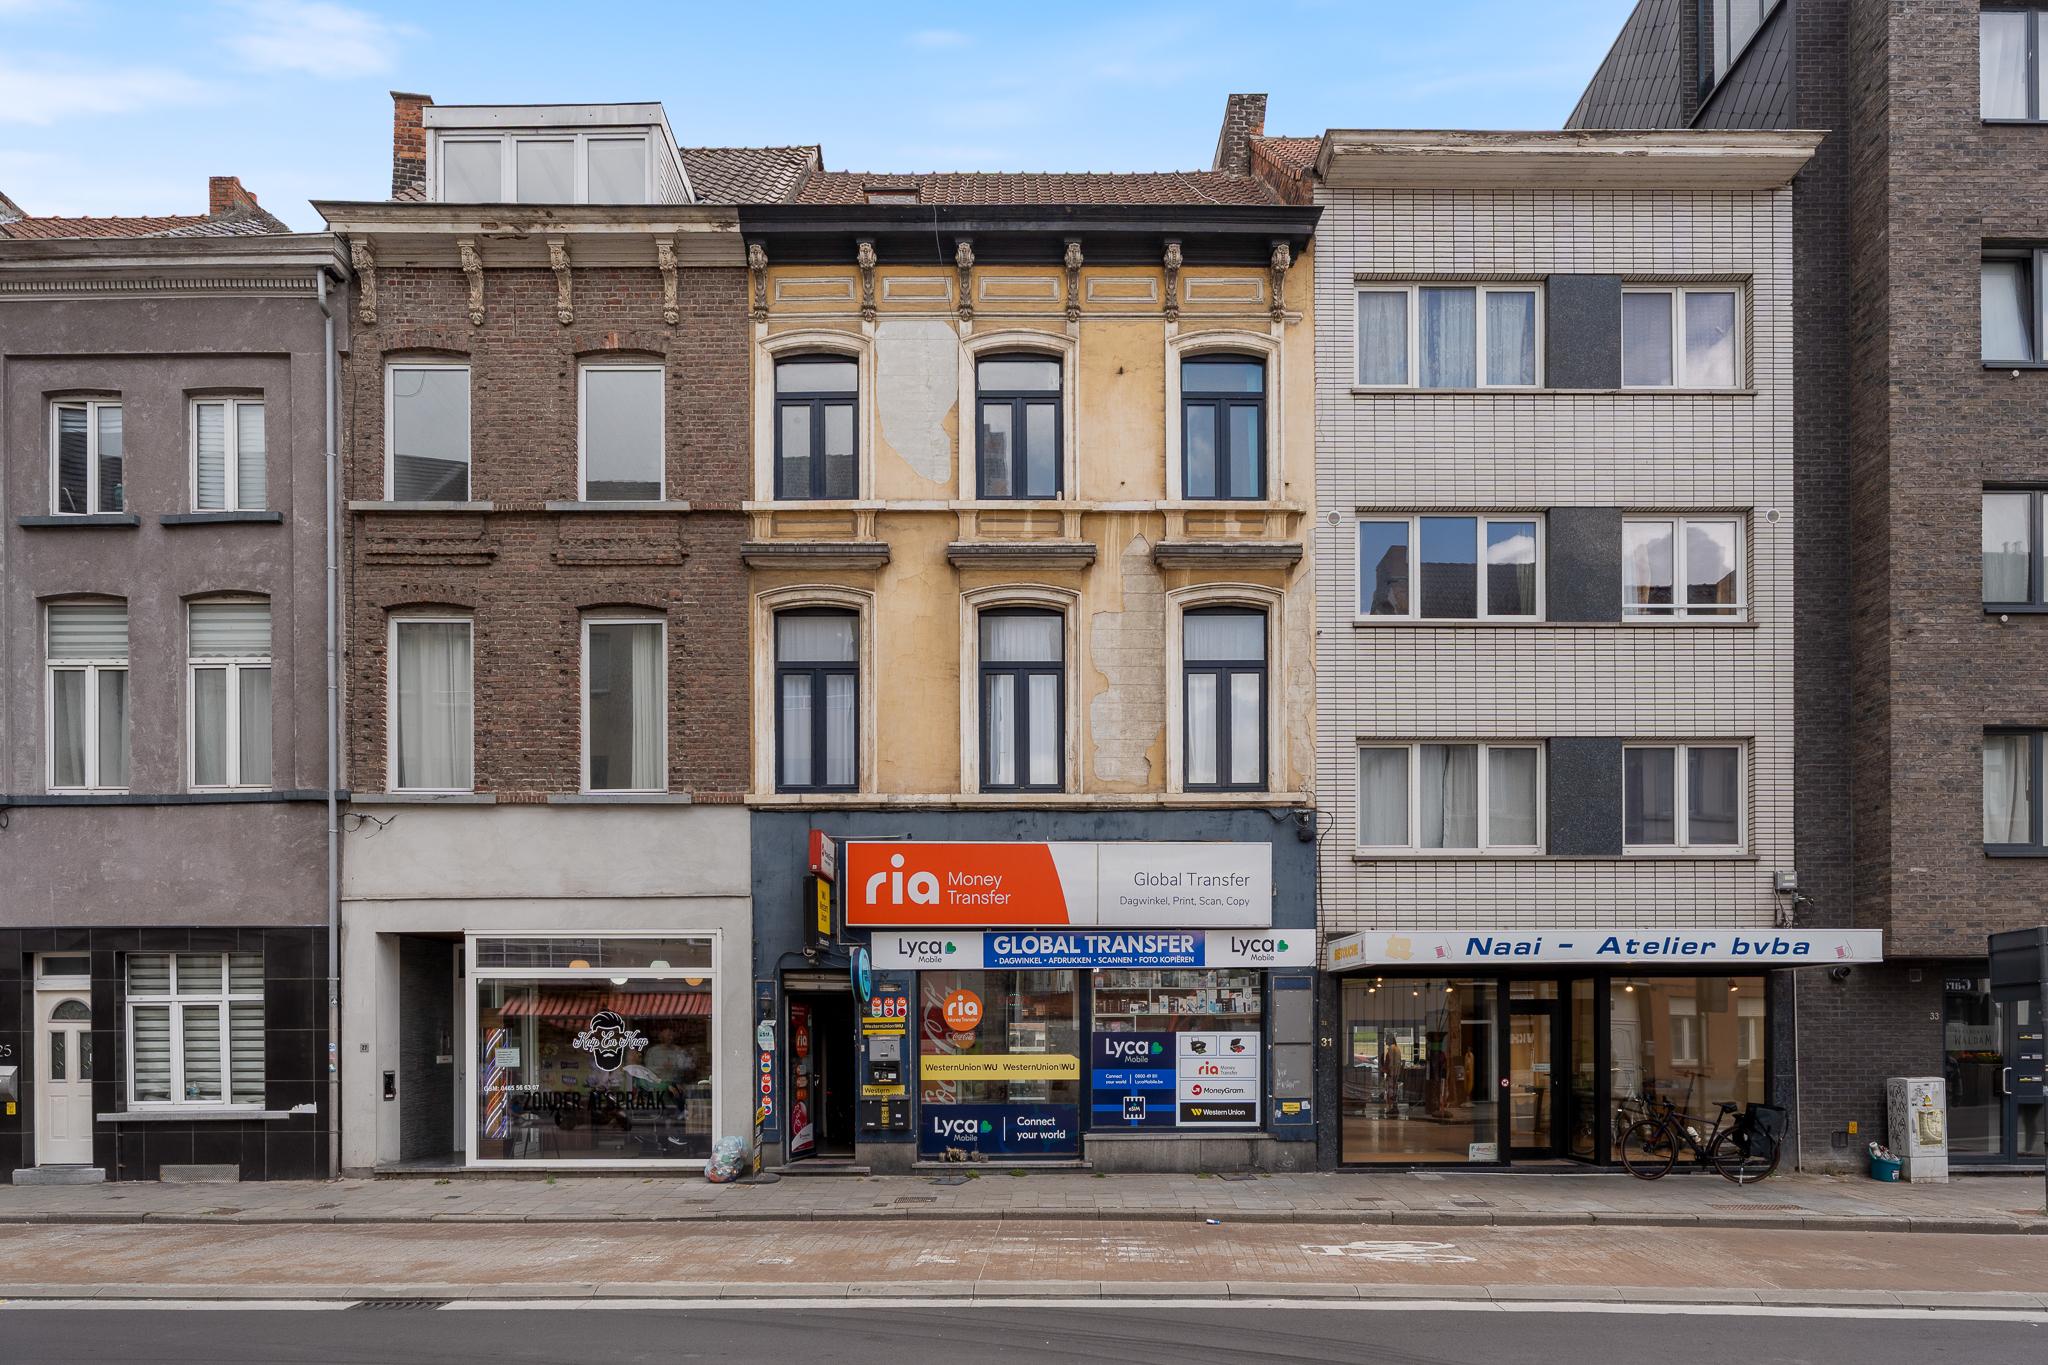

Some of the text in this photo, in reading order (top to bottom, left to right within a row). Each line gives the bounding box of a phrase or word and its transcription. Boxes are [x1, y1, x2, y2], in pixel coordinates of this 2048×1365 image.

[866, 853, 940, 905] ria
[948, 871, 1002, 889] Money
[1134, 871, 1250, 887] Global Transfer
[947, 890, 1011, 905] Transfer
[1120, 896, 1250, 908] Dagwinkel, Print, Scan, Copy
[899, 937, 942, 958] Lyca
[993, 935, 1194, 955] GLOBAL TRANSFER
[1231, 936, 1274, 957] Lyca
[1465, 936, 1542, 955] Naai
[1597, 936, 1716, 955] Atelier
[1731, 936, 1810, 955] bvba
[918, 955, 942, 963] Mobile
[999, 957, 1042, 965] DAGWINKEL
[1098, 956, 1133, 964] SCANNEN
[1160, 955, 1194, 963] KOPIËREN
[1250, 953, 1275, 961] Mobile
[948, 995, 978, 1016] ria
[1929, 1012, 1940, 1020] 33
[1105, 1037, 1149, 1058] Lyca
[1320, 1037, 1332, 1047] 31
[925, 1063, 982, 1071] WesternUnion
[1003, 1063, 1059, 1071] WesternUnion
[1198, 1061, 1219, 1075] ria
[1203, 1087, 1244, 1095] MoneyGram
[523, 1091, 581, 1111] ZONDER
[1202, 1108, 1246, 1116] Western Union
[934, 1116, 1056, 1137] Lyca Connect
[953, 1134, 978, 1142] Mobile
[1017, 1130, 1066, 1143] your world
